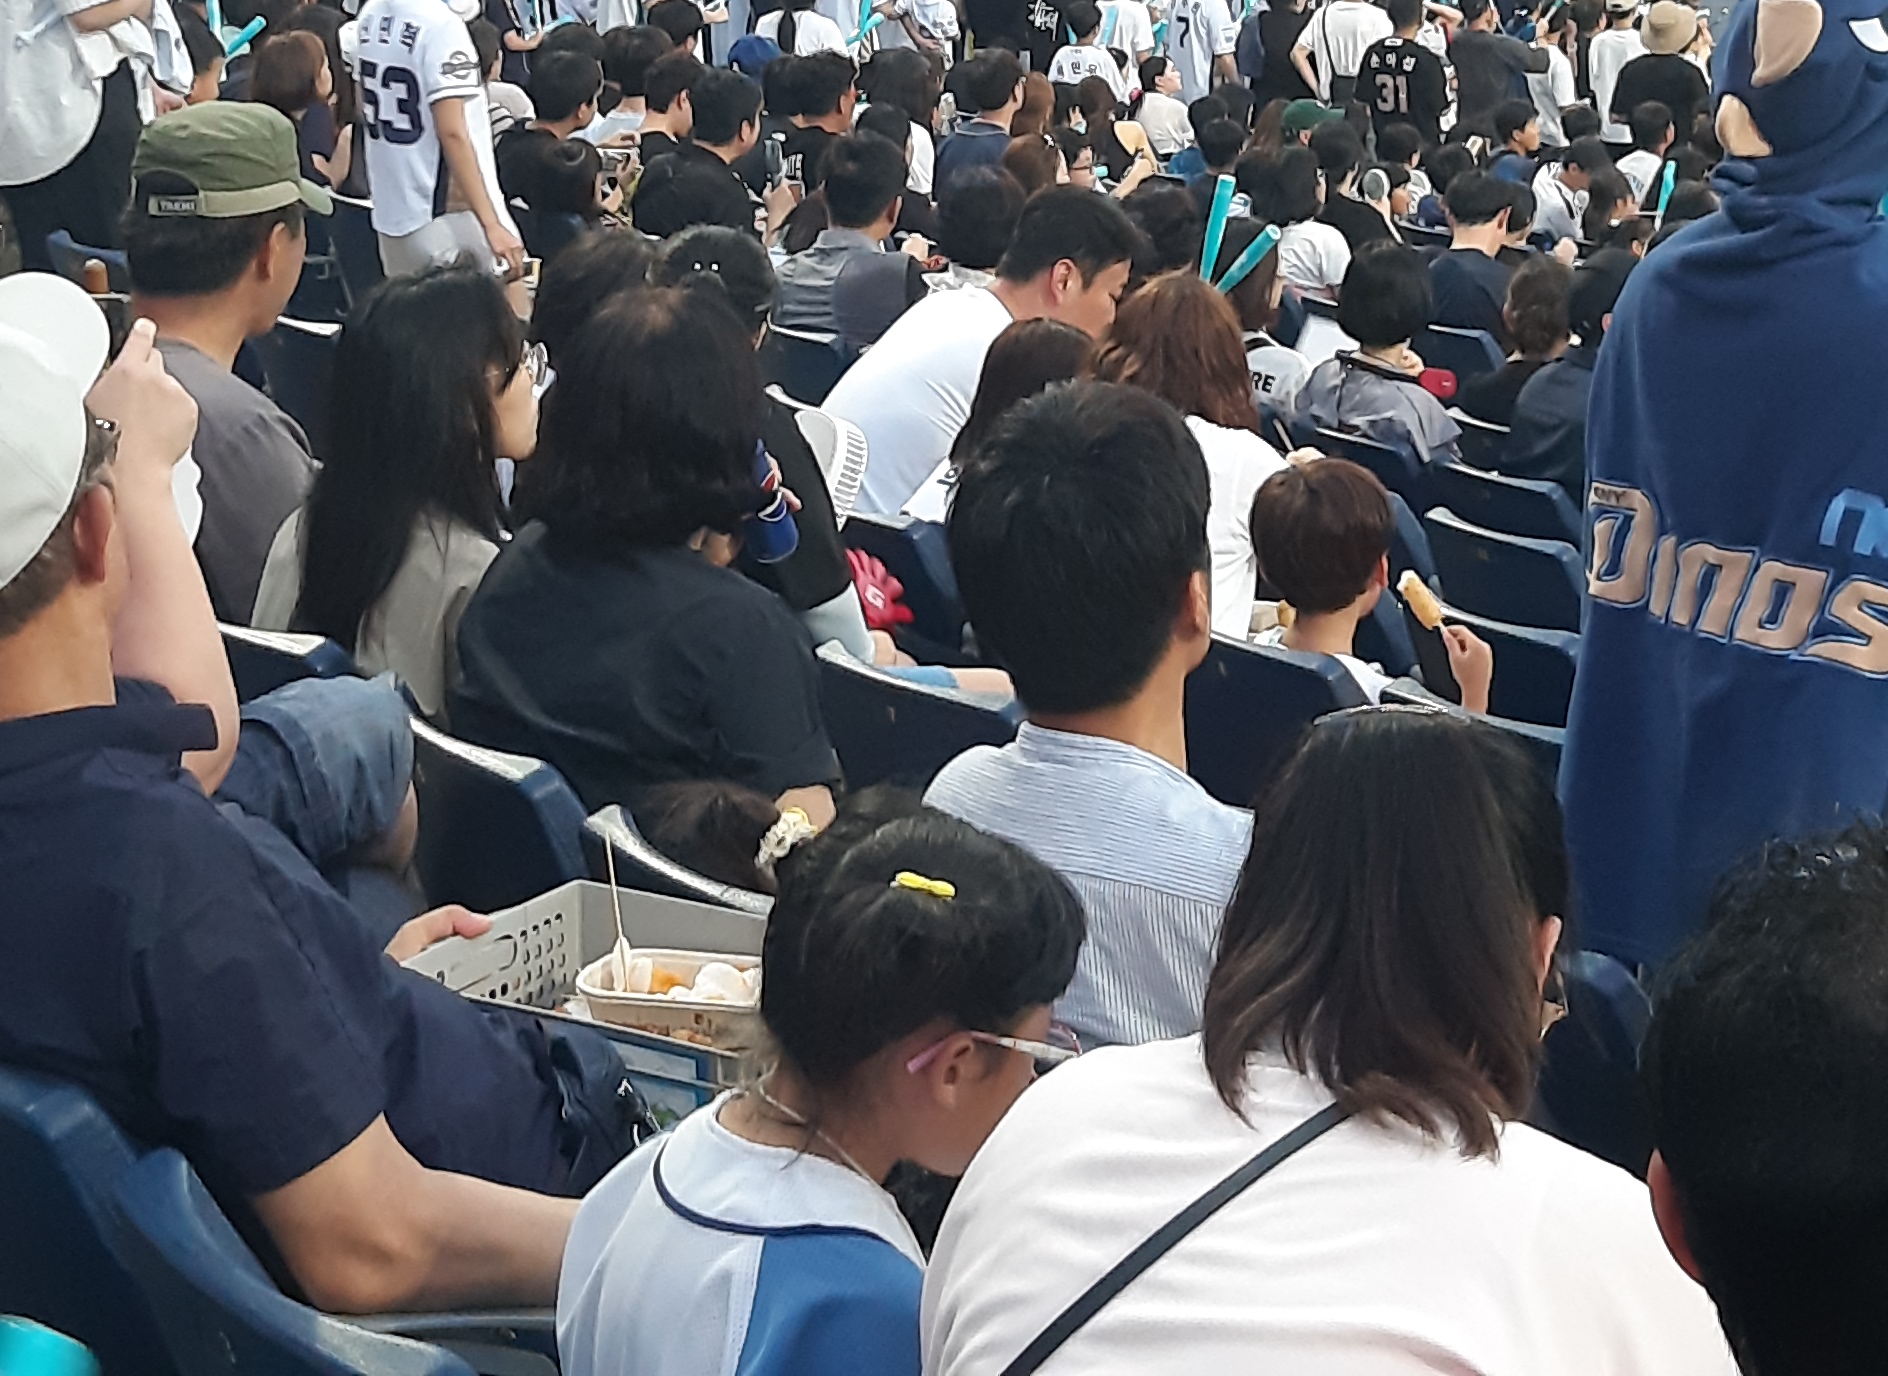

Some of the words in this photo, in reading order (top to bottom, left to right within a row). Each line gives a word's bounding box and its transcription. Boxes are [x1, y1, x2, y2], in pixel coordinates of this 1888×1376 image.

[1176, 15, 1189, 48] 7
[359, 61, 425, 145] 53
[1376, 73, 1409, 113] 31
